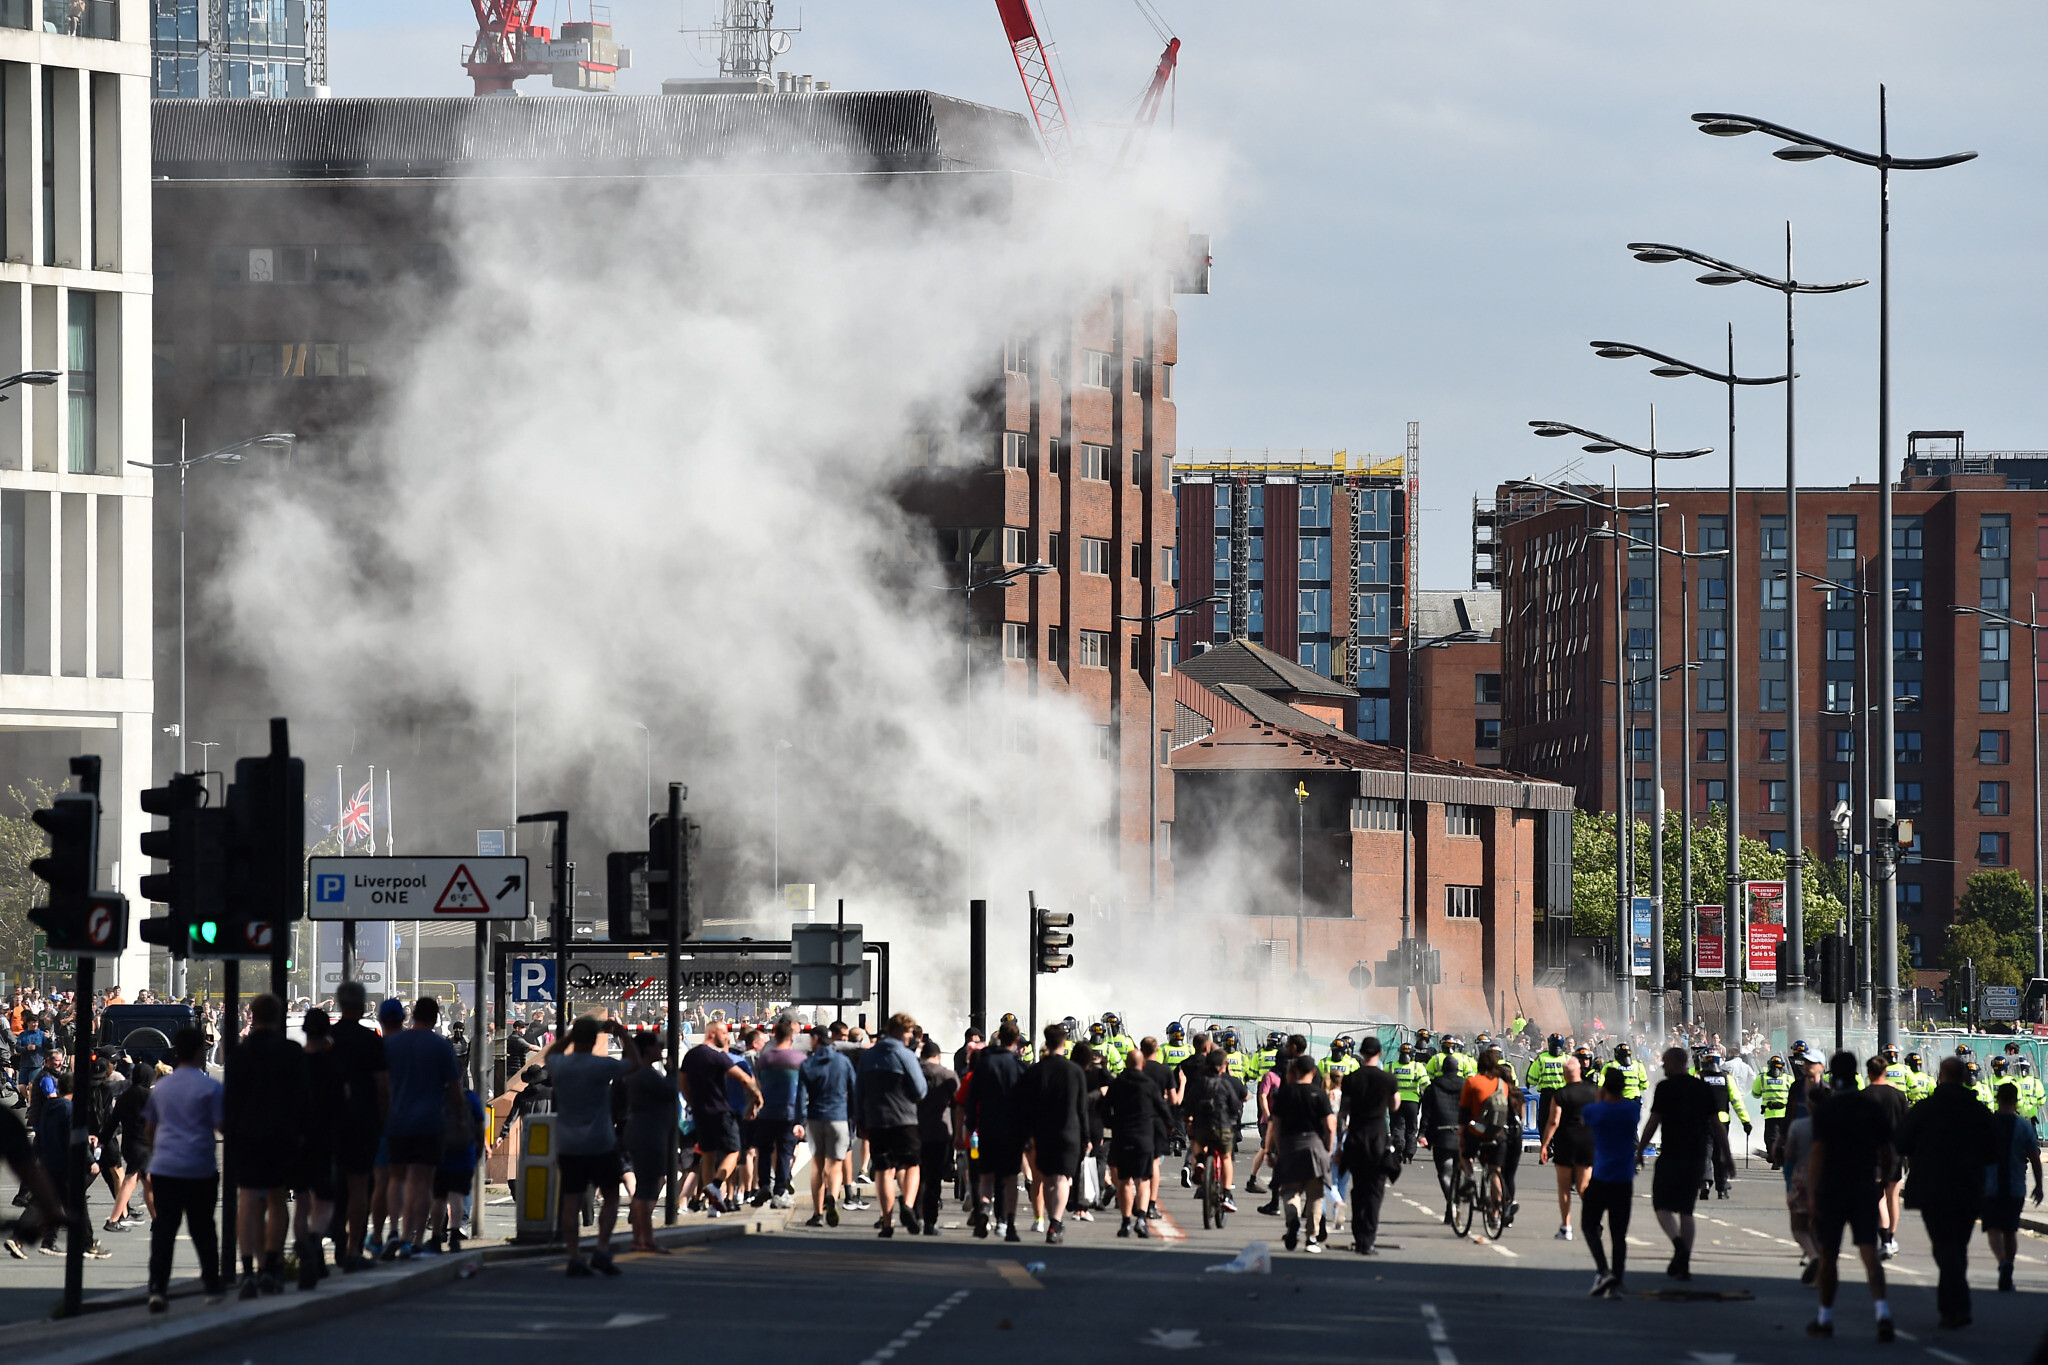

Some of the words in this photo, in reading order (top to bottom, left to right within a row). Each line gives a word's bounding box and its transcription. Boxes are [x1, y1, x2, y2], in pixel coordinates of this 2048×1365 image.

[548, 45, 583, 58] legacie
[323, 878, 341, 899] P
[354, 875, 427, 890] Liverpool
[371, 891, 408, 904] ONE
[520, 963, 547, 1000] P
